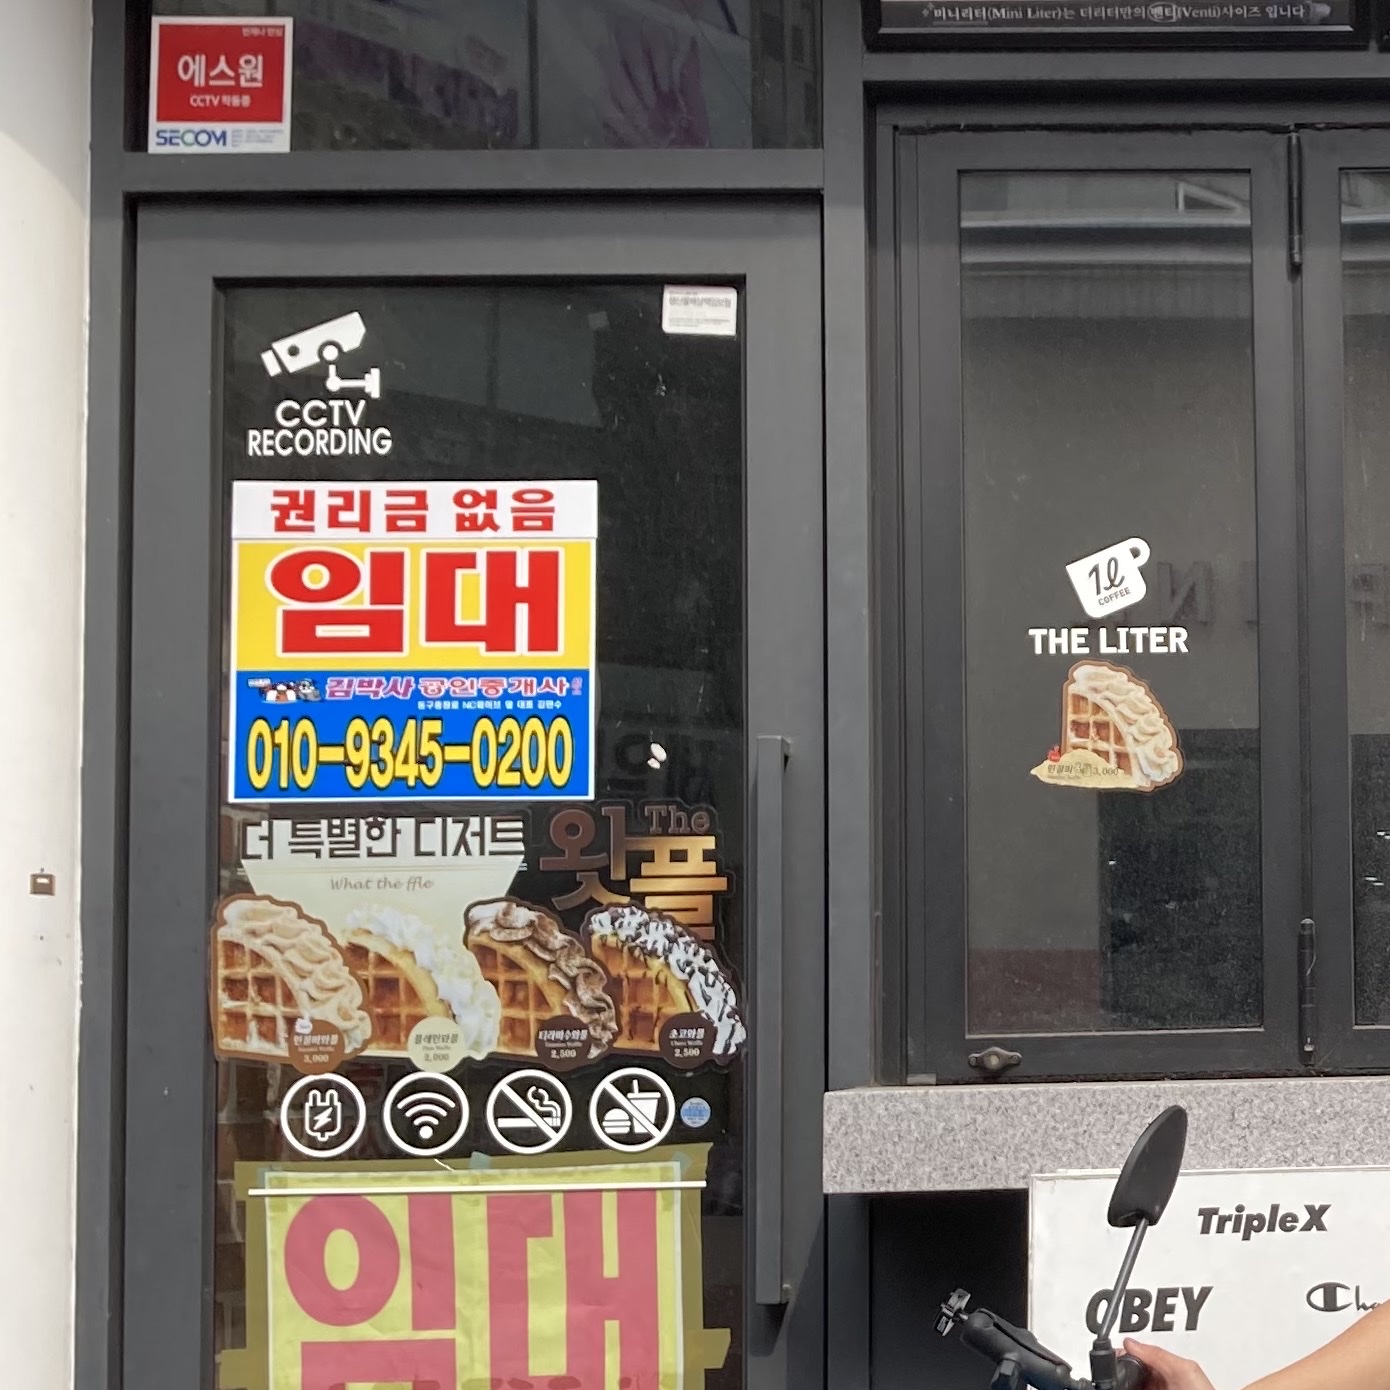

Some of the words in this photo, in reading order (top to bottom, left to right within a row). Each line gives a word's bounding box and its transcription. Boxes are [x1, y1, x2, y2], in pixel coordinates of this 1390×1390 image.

[177, 54, 263, 88] 에스원
[189, 95, 220, 108] CCTV
[156, 129, 227, 147] SECOM
[275, 400, 366, 428] CCTV
[247, 428, 393, 457] RECORDING
[271, 489, 429, 533] 권리금
[452, 488, 556, 532] 없음
[271, 548, 563, 653] 임대
[1098, 586, 1131, 606] COFFEE
[1028, 627, 1090, 654] THE
[1099, 626, 1189, 654] LITER
[326, 677, 413, 700] 김박사
[418, 676, 569, 699] 공인중개사
[247, 717, 575, 789] 010-9345-0200
[1093, 767, 1119, 777] 3,000
[645, 805, 711, 834] The
[242, 820, 273, 859] 더
[288, 816, 401, 858] 특별한
[415, 816, 525, 857] 디저트
[330, 876, 375, 890] What
[377, 875, 404, 890] the
[303, 1054, 329, 1063] 3,000
[551, 1049, 577, 1059] 2,500
[674, 1047, 701, 1058] 2,500
[1197, 1204, 1332, 1241] TripleX
[1085, 1286, 1214, 1334] OBEY
